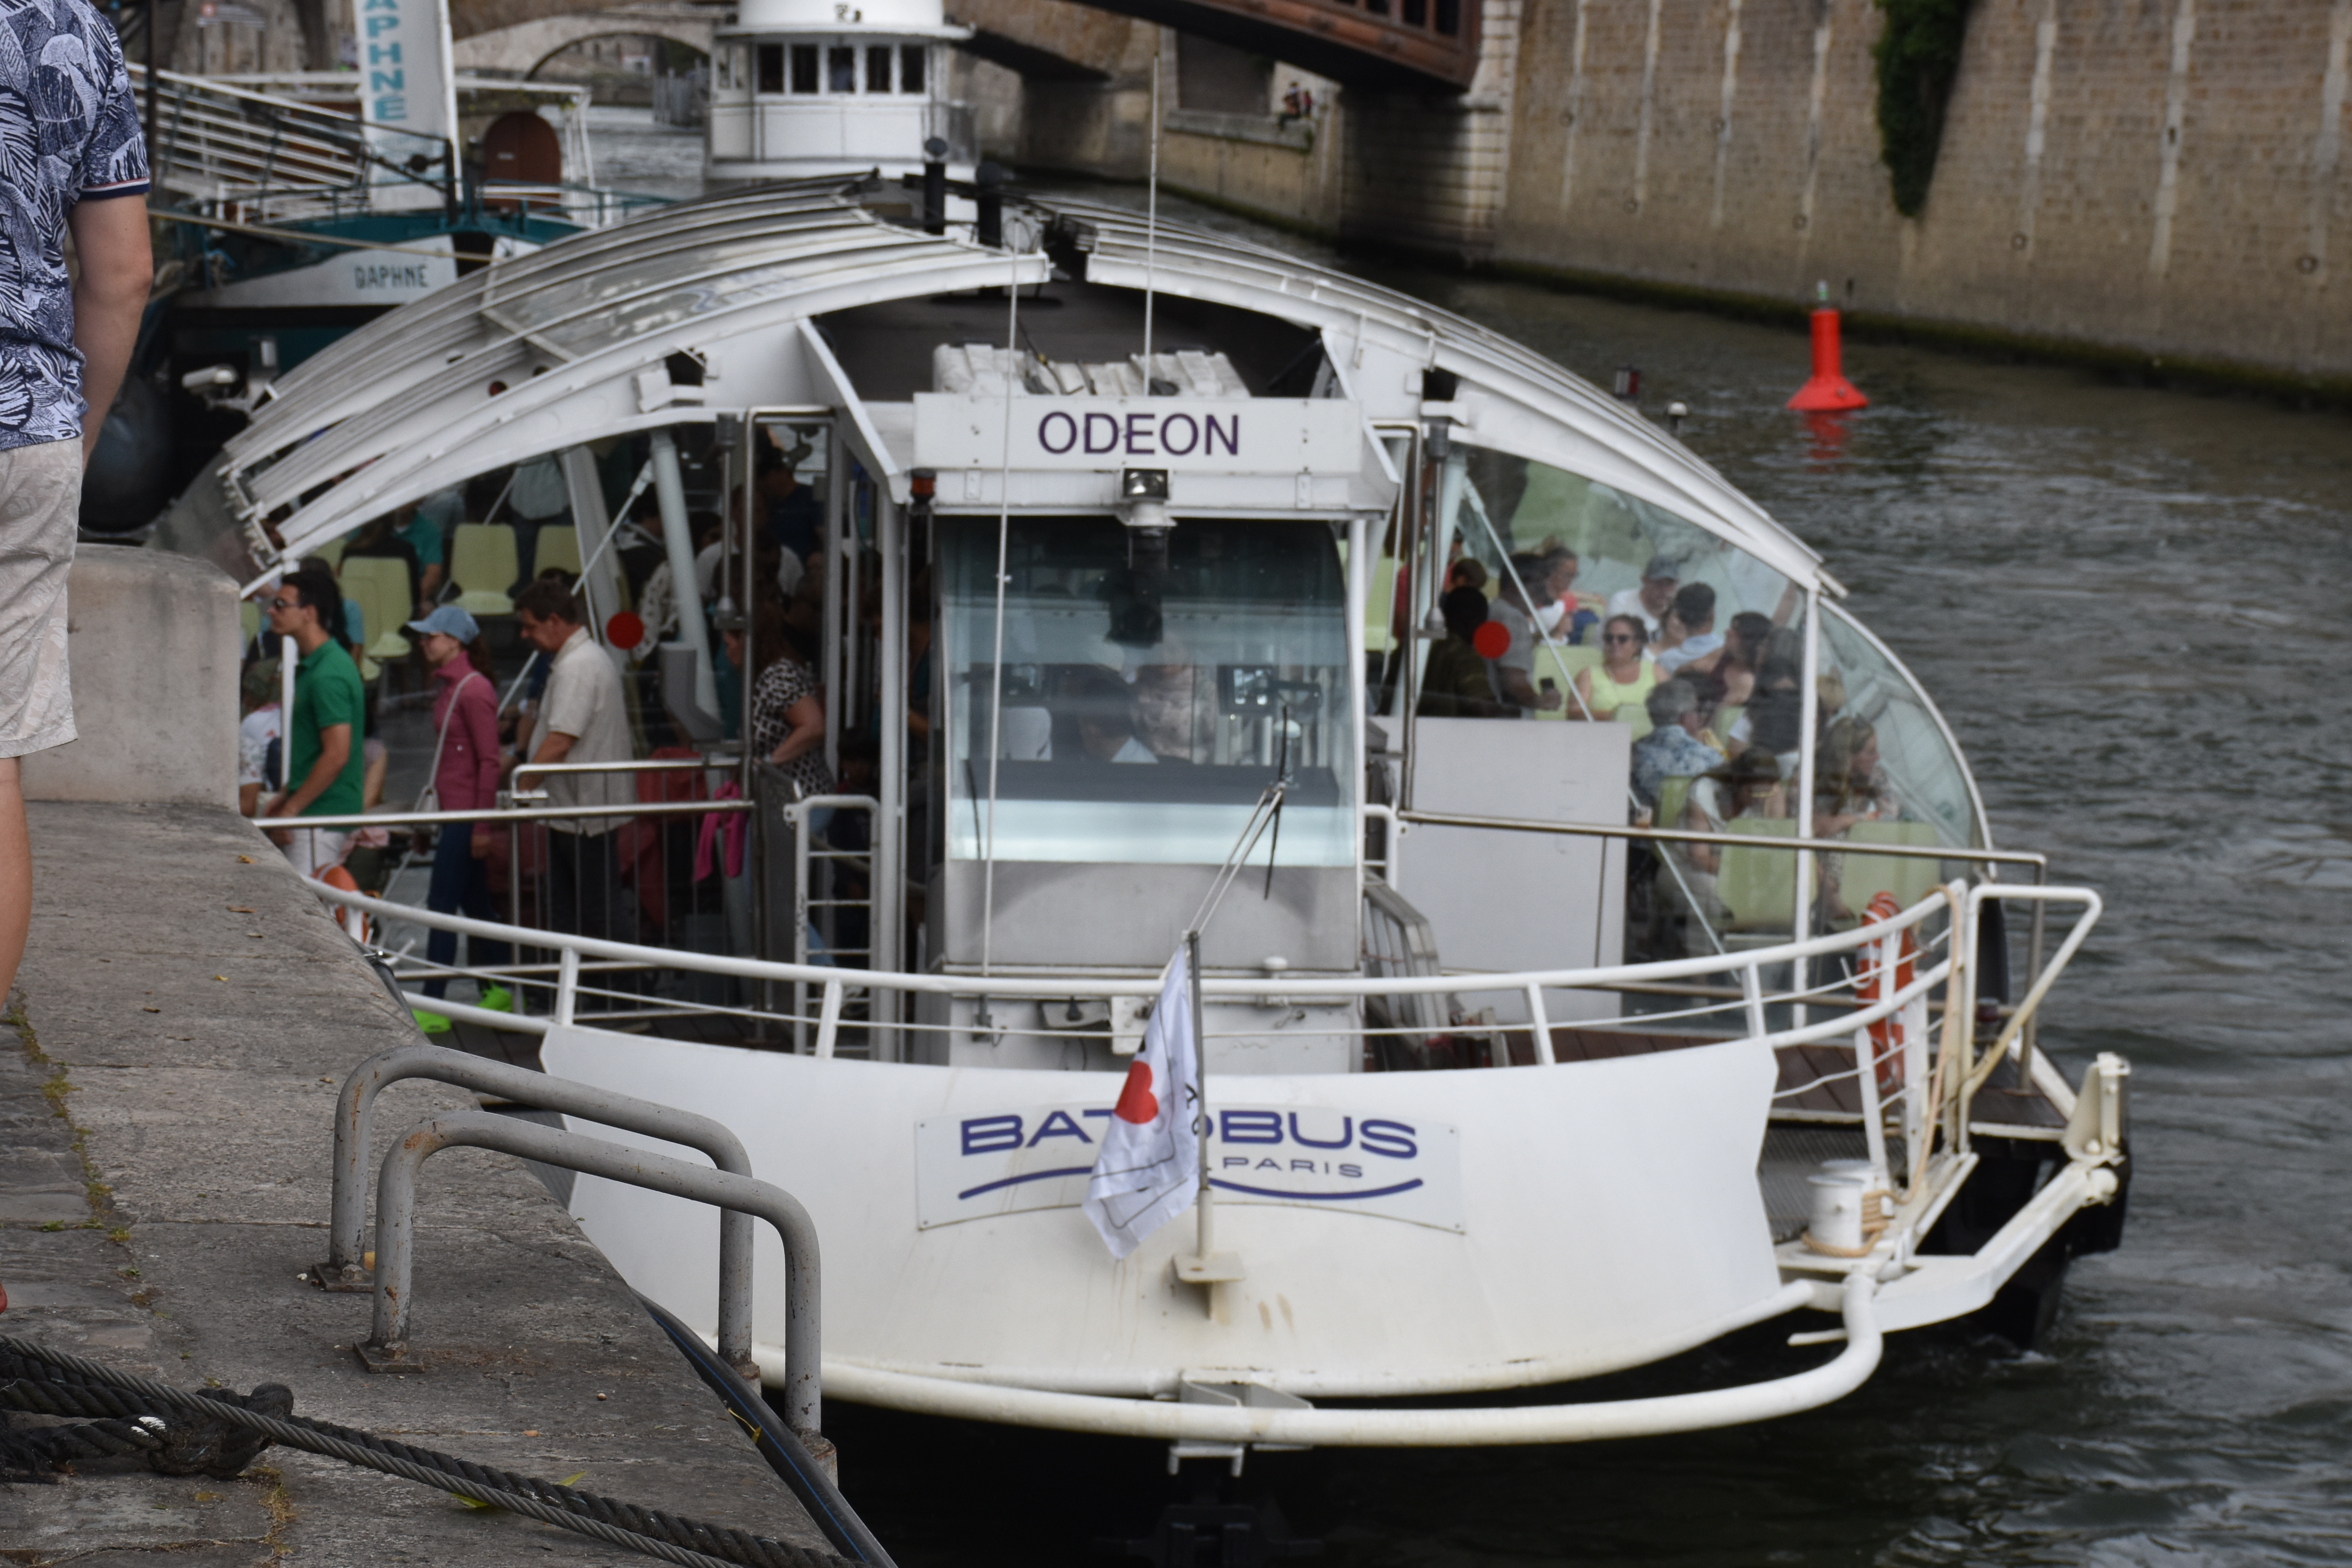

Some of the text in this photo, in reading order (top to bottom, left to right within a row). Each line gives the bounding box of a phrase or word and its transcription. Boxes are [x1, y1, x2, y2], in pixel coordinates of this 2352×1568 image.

[355, 265, 428, 289] DAPHNE
[1038, 411, 1239, 456] ODEON
[961, 1108, 1417, 1159] BABUS
[1223, 1157, 1363, 1177] PARIS
